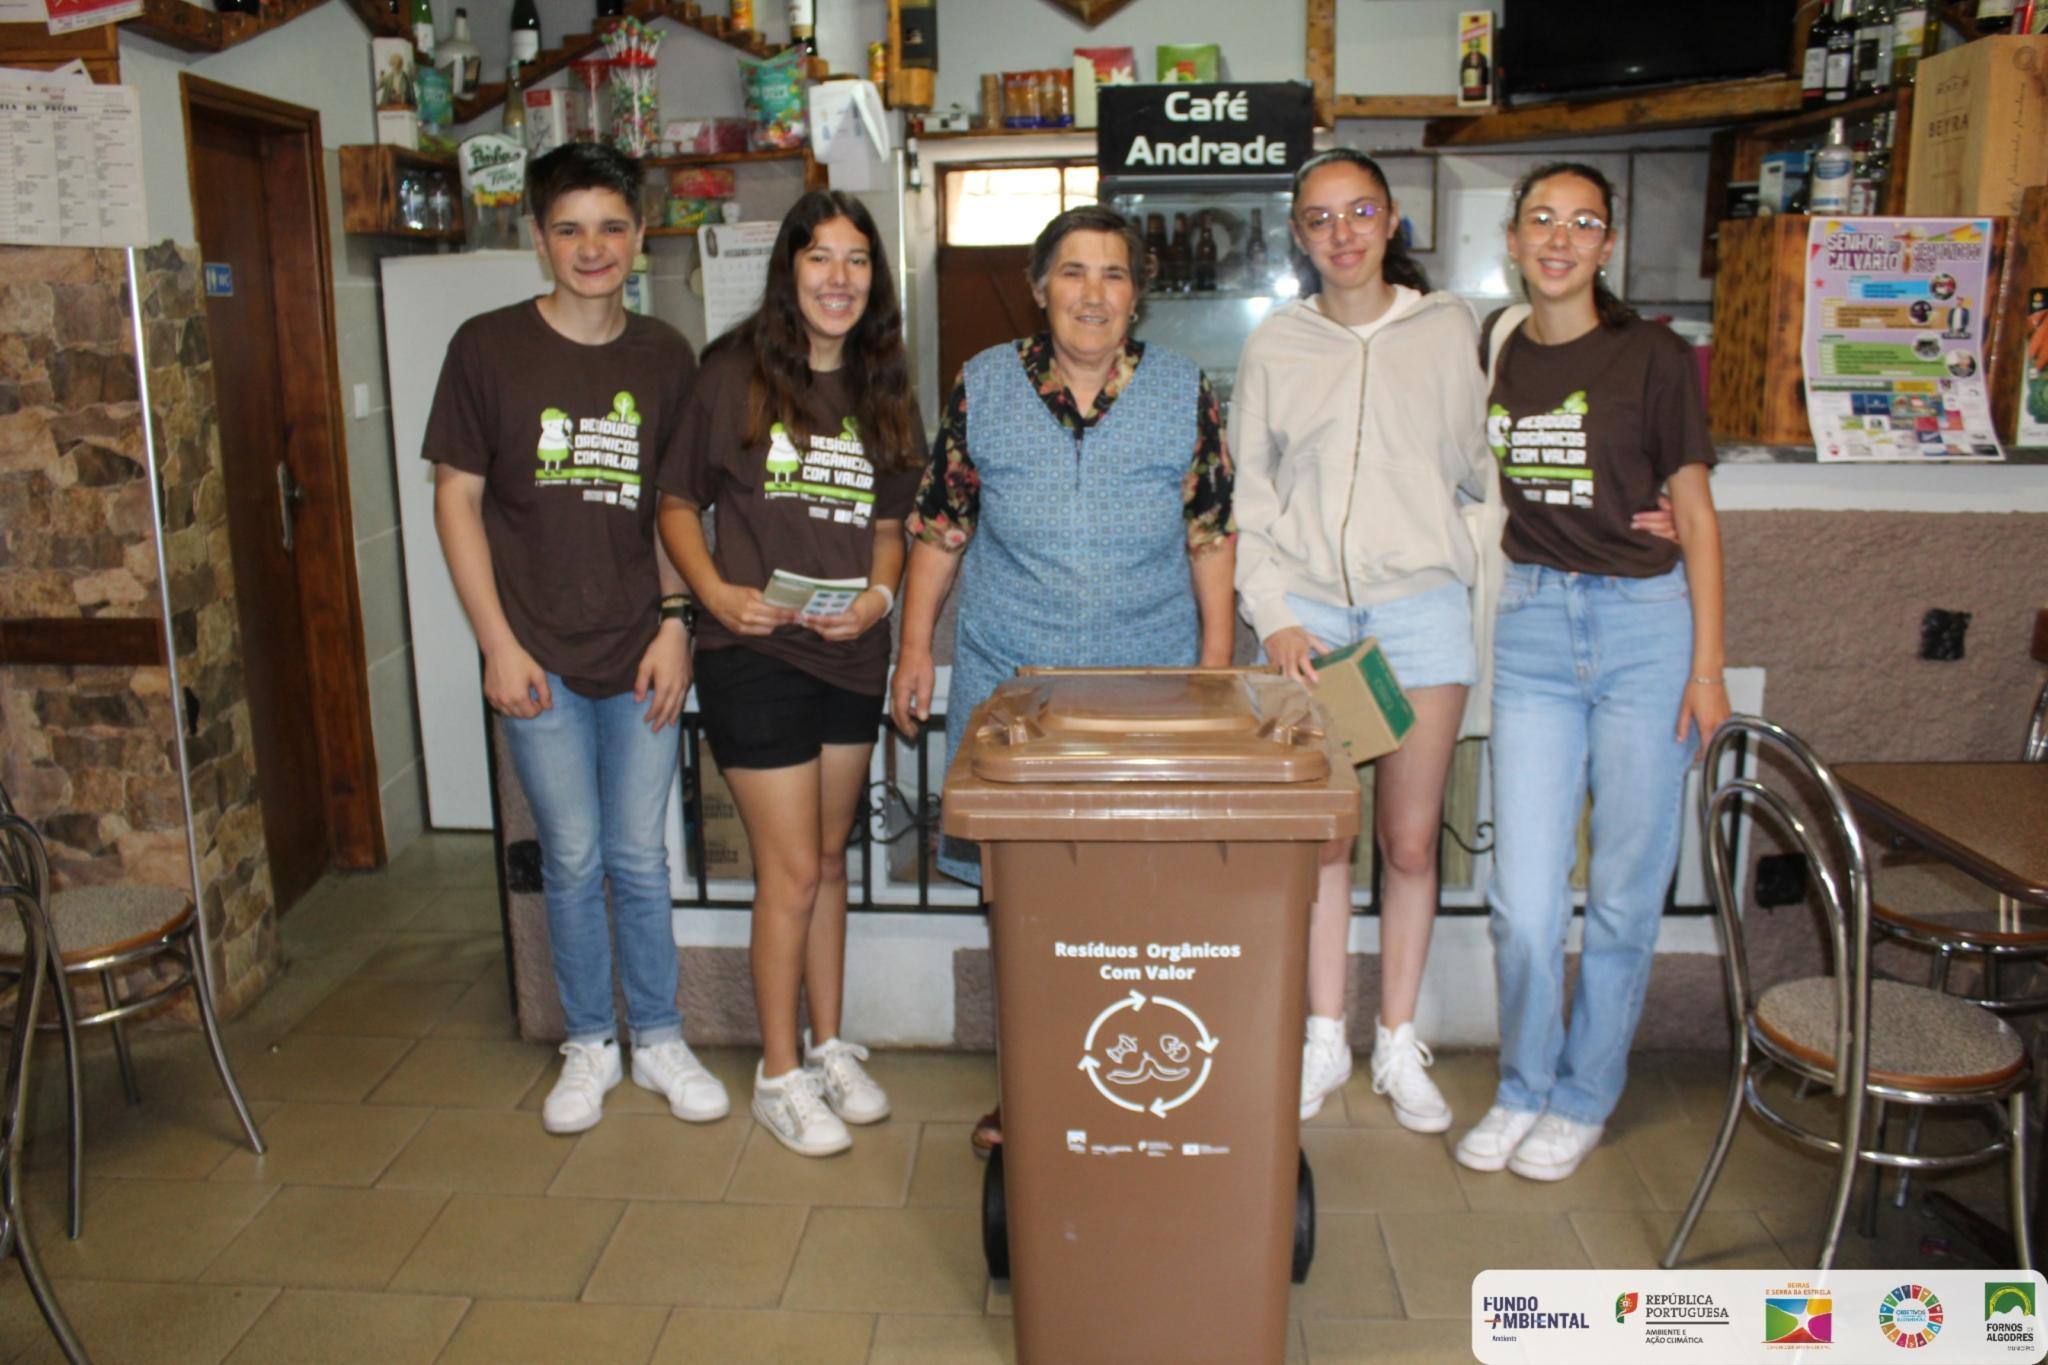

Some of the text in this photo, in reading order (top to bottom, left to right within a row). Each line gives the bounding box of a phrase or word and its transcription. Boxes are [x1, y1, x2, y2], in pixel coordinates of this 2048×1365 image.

[1164, 91, 1249, 122] Café
[1928, 113, 1969, 138] BEYRA
[1125, 135, 1287, 166] Andrade
[1827, 233, 1885, 251] SENHOR
[573, 450, 601, 466] COM
[1511, 448, 1587, 465] COM VALOR
[802, 466, 875, 490] COM VALOR
[1054, 941, 1242, 962] Resíduos Orgânicos
[1099, 965, 1197, 980] Com Valor
